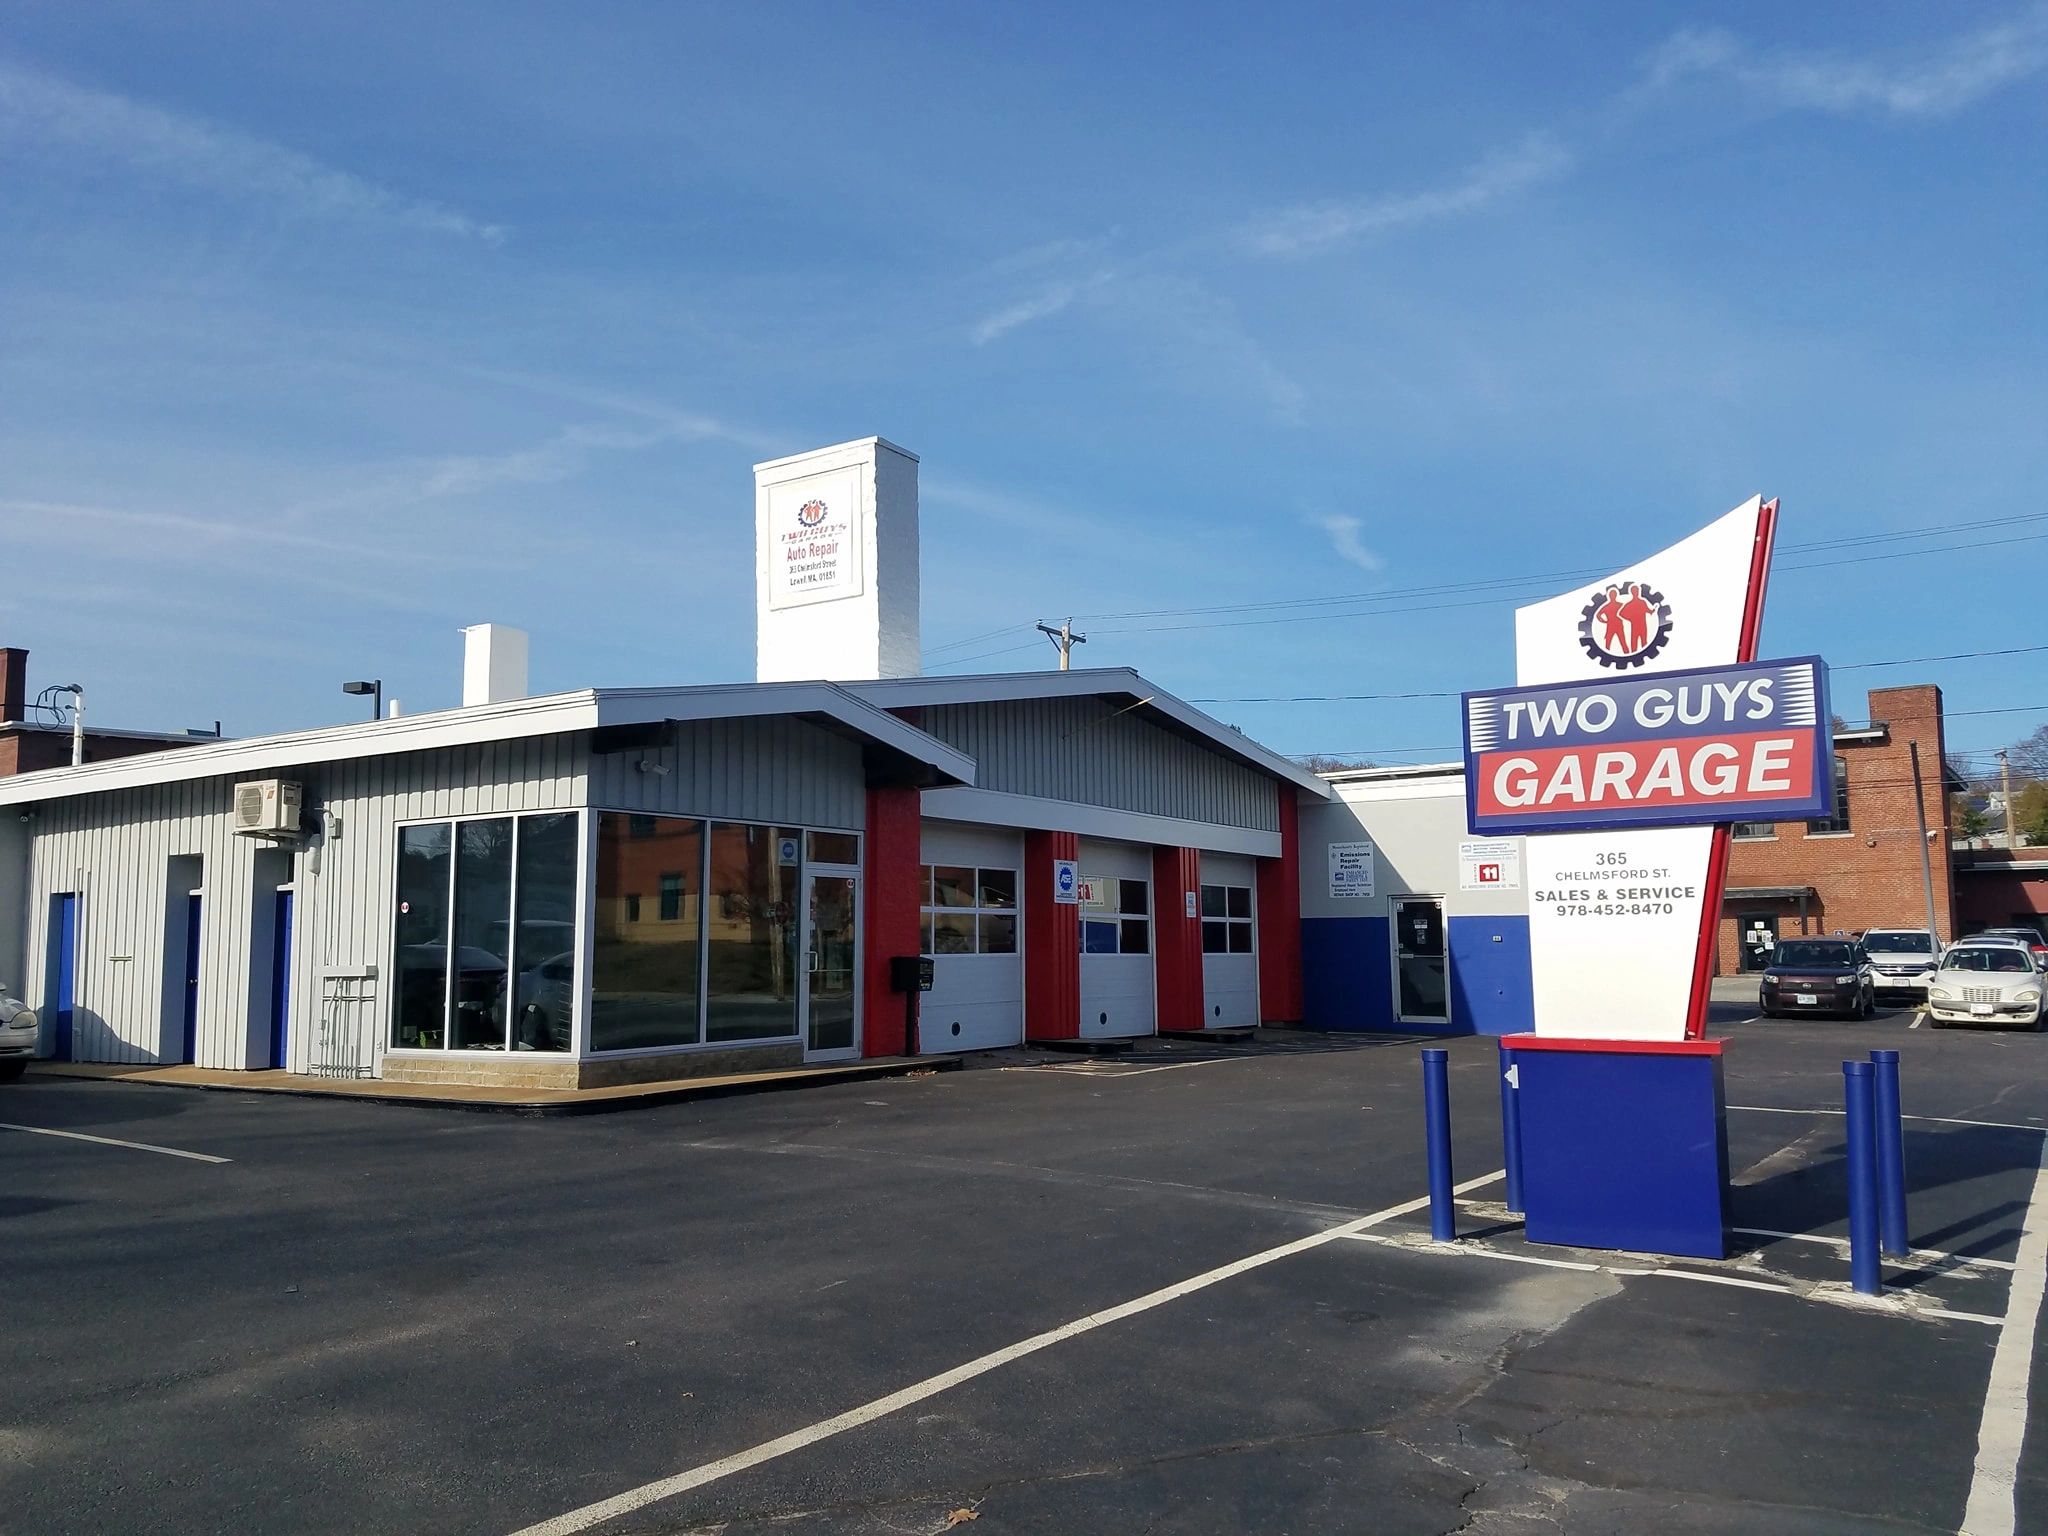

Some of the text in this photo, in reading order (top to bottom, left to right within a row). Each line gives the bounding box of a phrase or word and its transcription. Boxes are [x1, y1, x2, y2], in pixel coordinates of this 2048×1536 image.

[787, 539, 839, 562] Auto Repair
[1503, 678, 1774, 740] TWO GUYS
[1493, 739, 1794, 807] GARAGE
[1596, 852, 1627, 865] 365
[1482, 867, 1498, 879] 11
[1555, 868, 1671, 881] CHELMSFORD ST.
[1535, 886, 1695, 902] SALES & SERVICE
[1556, 903, 1673, 916] 978-452-8470
